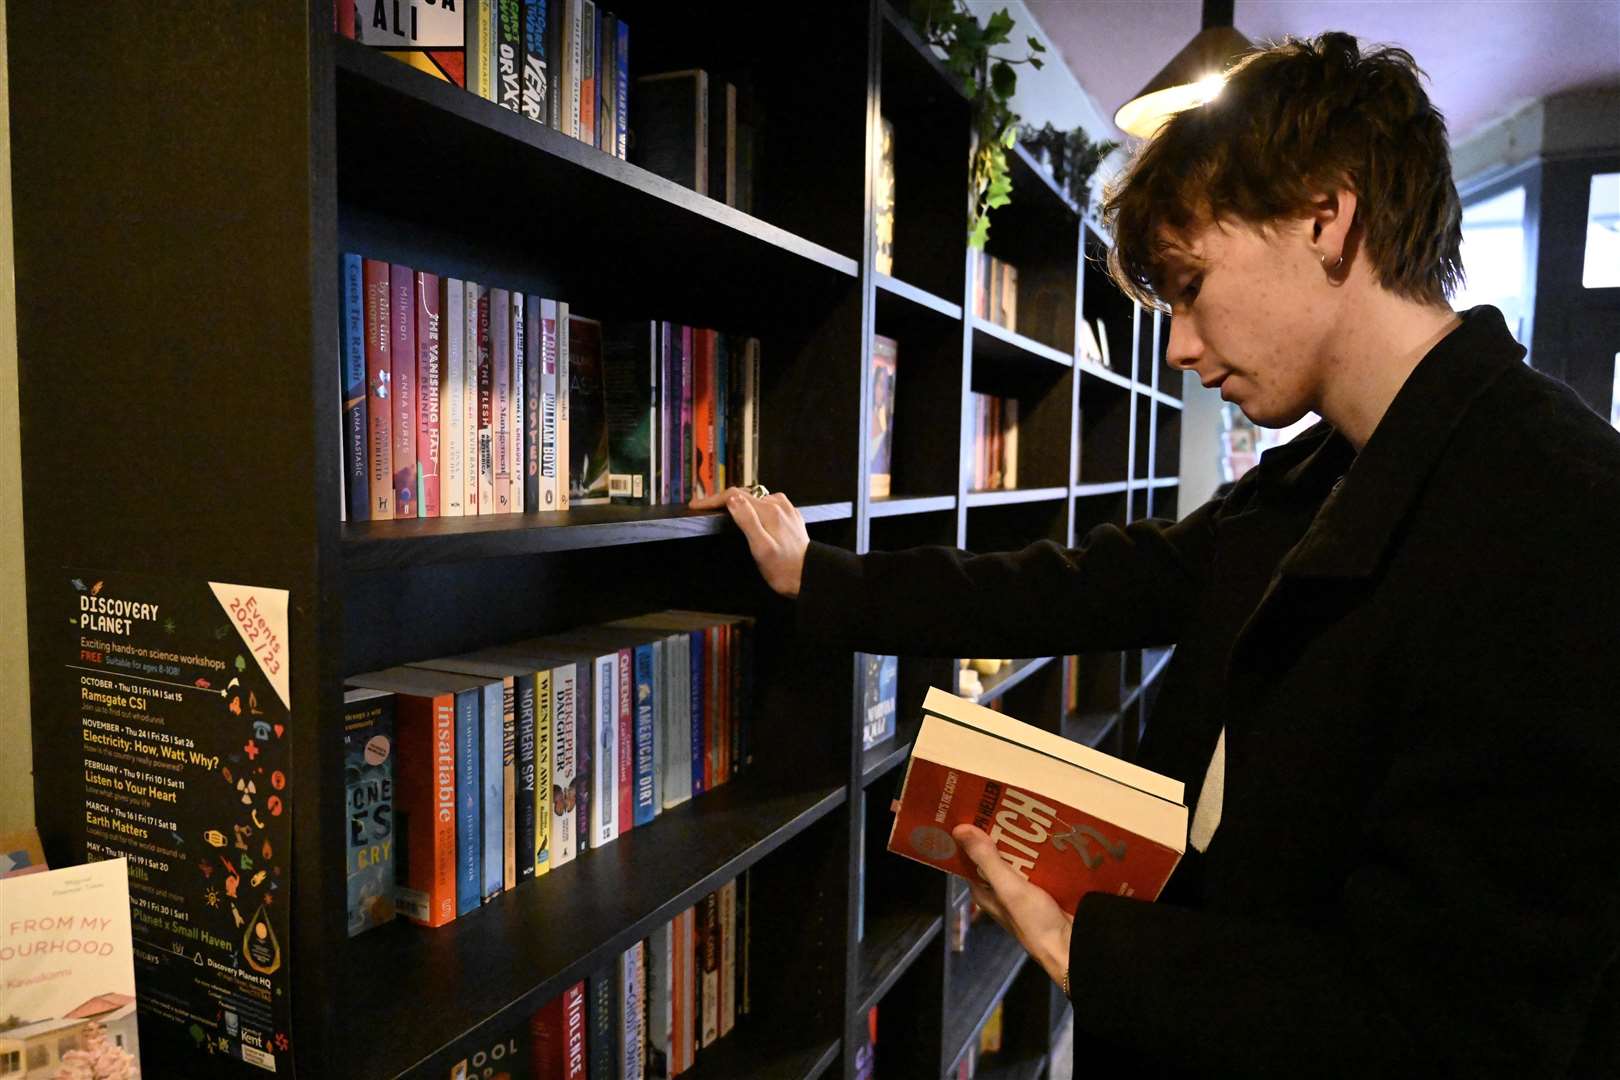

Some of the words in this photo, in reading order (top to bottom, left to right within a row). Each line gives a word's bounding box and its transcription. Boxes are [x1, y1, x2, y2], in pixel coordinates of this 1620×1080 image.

[373, 0, 417, 41] ALI
[500, 43, 520, 101] ORYX
[522, 54, 547, 120] YEAR
[399, 286, 409, 341] Milkman
[430, 314, 439, 340] THE
[380, 323, 389, 352] time
[400, 373, 409, 408] ANNA
[430, 344, 439, 422] VANISHING
[481, 364, 489, 385] THE
[421, 376, 429, 434] BENNETT
[481, 391, 489, 427] FLESH
[543, 393, 555, 444] WILLIAM
[430, 428, 439, 465] HALF
[543, 447, 555, 478] BOYD
[81, 595, 159, 621] DISCOVERY
[81, 613, 132, 636] PLANET
[245, 596, 280, 653] Events
[230, 597, 259, 643] 2022
[264, 652, 280, 675] 23
[80, 650, 102, 664] FREE
[81, 637, 111, 653] Exciting
[112, 641, 148, 657] hands-on
[150, 649, 179, 662] science
[181, 653, 226, 671] workshops
[81, 676, 113, 689] OCTOBER
[119, 683, 130, 692] Thu
[81, 688, 127, 707] Ramsgate
[129, 696, 147, 711] CSI
[540, 679, 549, 723] WHEN
[620, 654, 629, 717] QUEENIE
[83, 718, 119, 733] NOVEMBER
[125, 726, 137, 737] Thu
[521, 689, 533, 761] NORTHERN
[556, 691, 566, 772] DAUGHTER
[564, 679, 575, 778] FIREKEEPER'S
[639, 705, 652, 774] AMERICAN
[83, 729, 133, 752] Electricity:
[135, 740, 159, 757] How,
[190, 751, 219, 770] Why?
[503, 720, 515, 767] BANKS
[540, 735, 548, 764] RAN
[85, 760, 118, 774] FEBRUARY
[124, 766, 135, 778] Thu
[438, 705, 454, 822] insatiable
[521, 765, 534, 791] SPY
[85, 770, 112, 787] Listen
[114, 778, 123, 790] to
[125, 780, 147, 796] Your
[149, 785, 177, 804] Heart
[540, 767, 548, 801] AWAY
[640, 776, 652, 806] DIRT
[86, 800, 110, 813] MARCH
[86, 811, 110, 828] Earth
[112, 819, 148, 839] Matters
[982, 787, 1057, 883] ATCH
[87, 841, 100, 852] MAY
[10, 916, 73, 936] FROM
[80, 916, 113, 932] MY
[172, 921, 199, 941] Small
[201, 930, 233, 951] Haven
[208, 958, 237, 976] Discovery
[567, 994, 583, 1078] VIOLENCE
